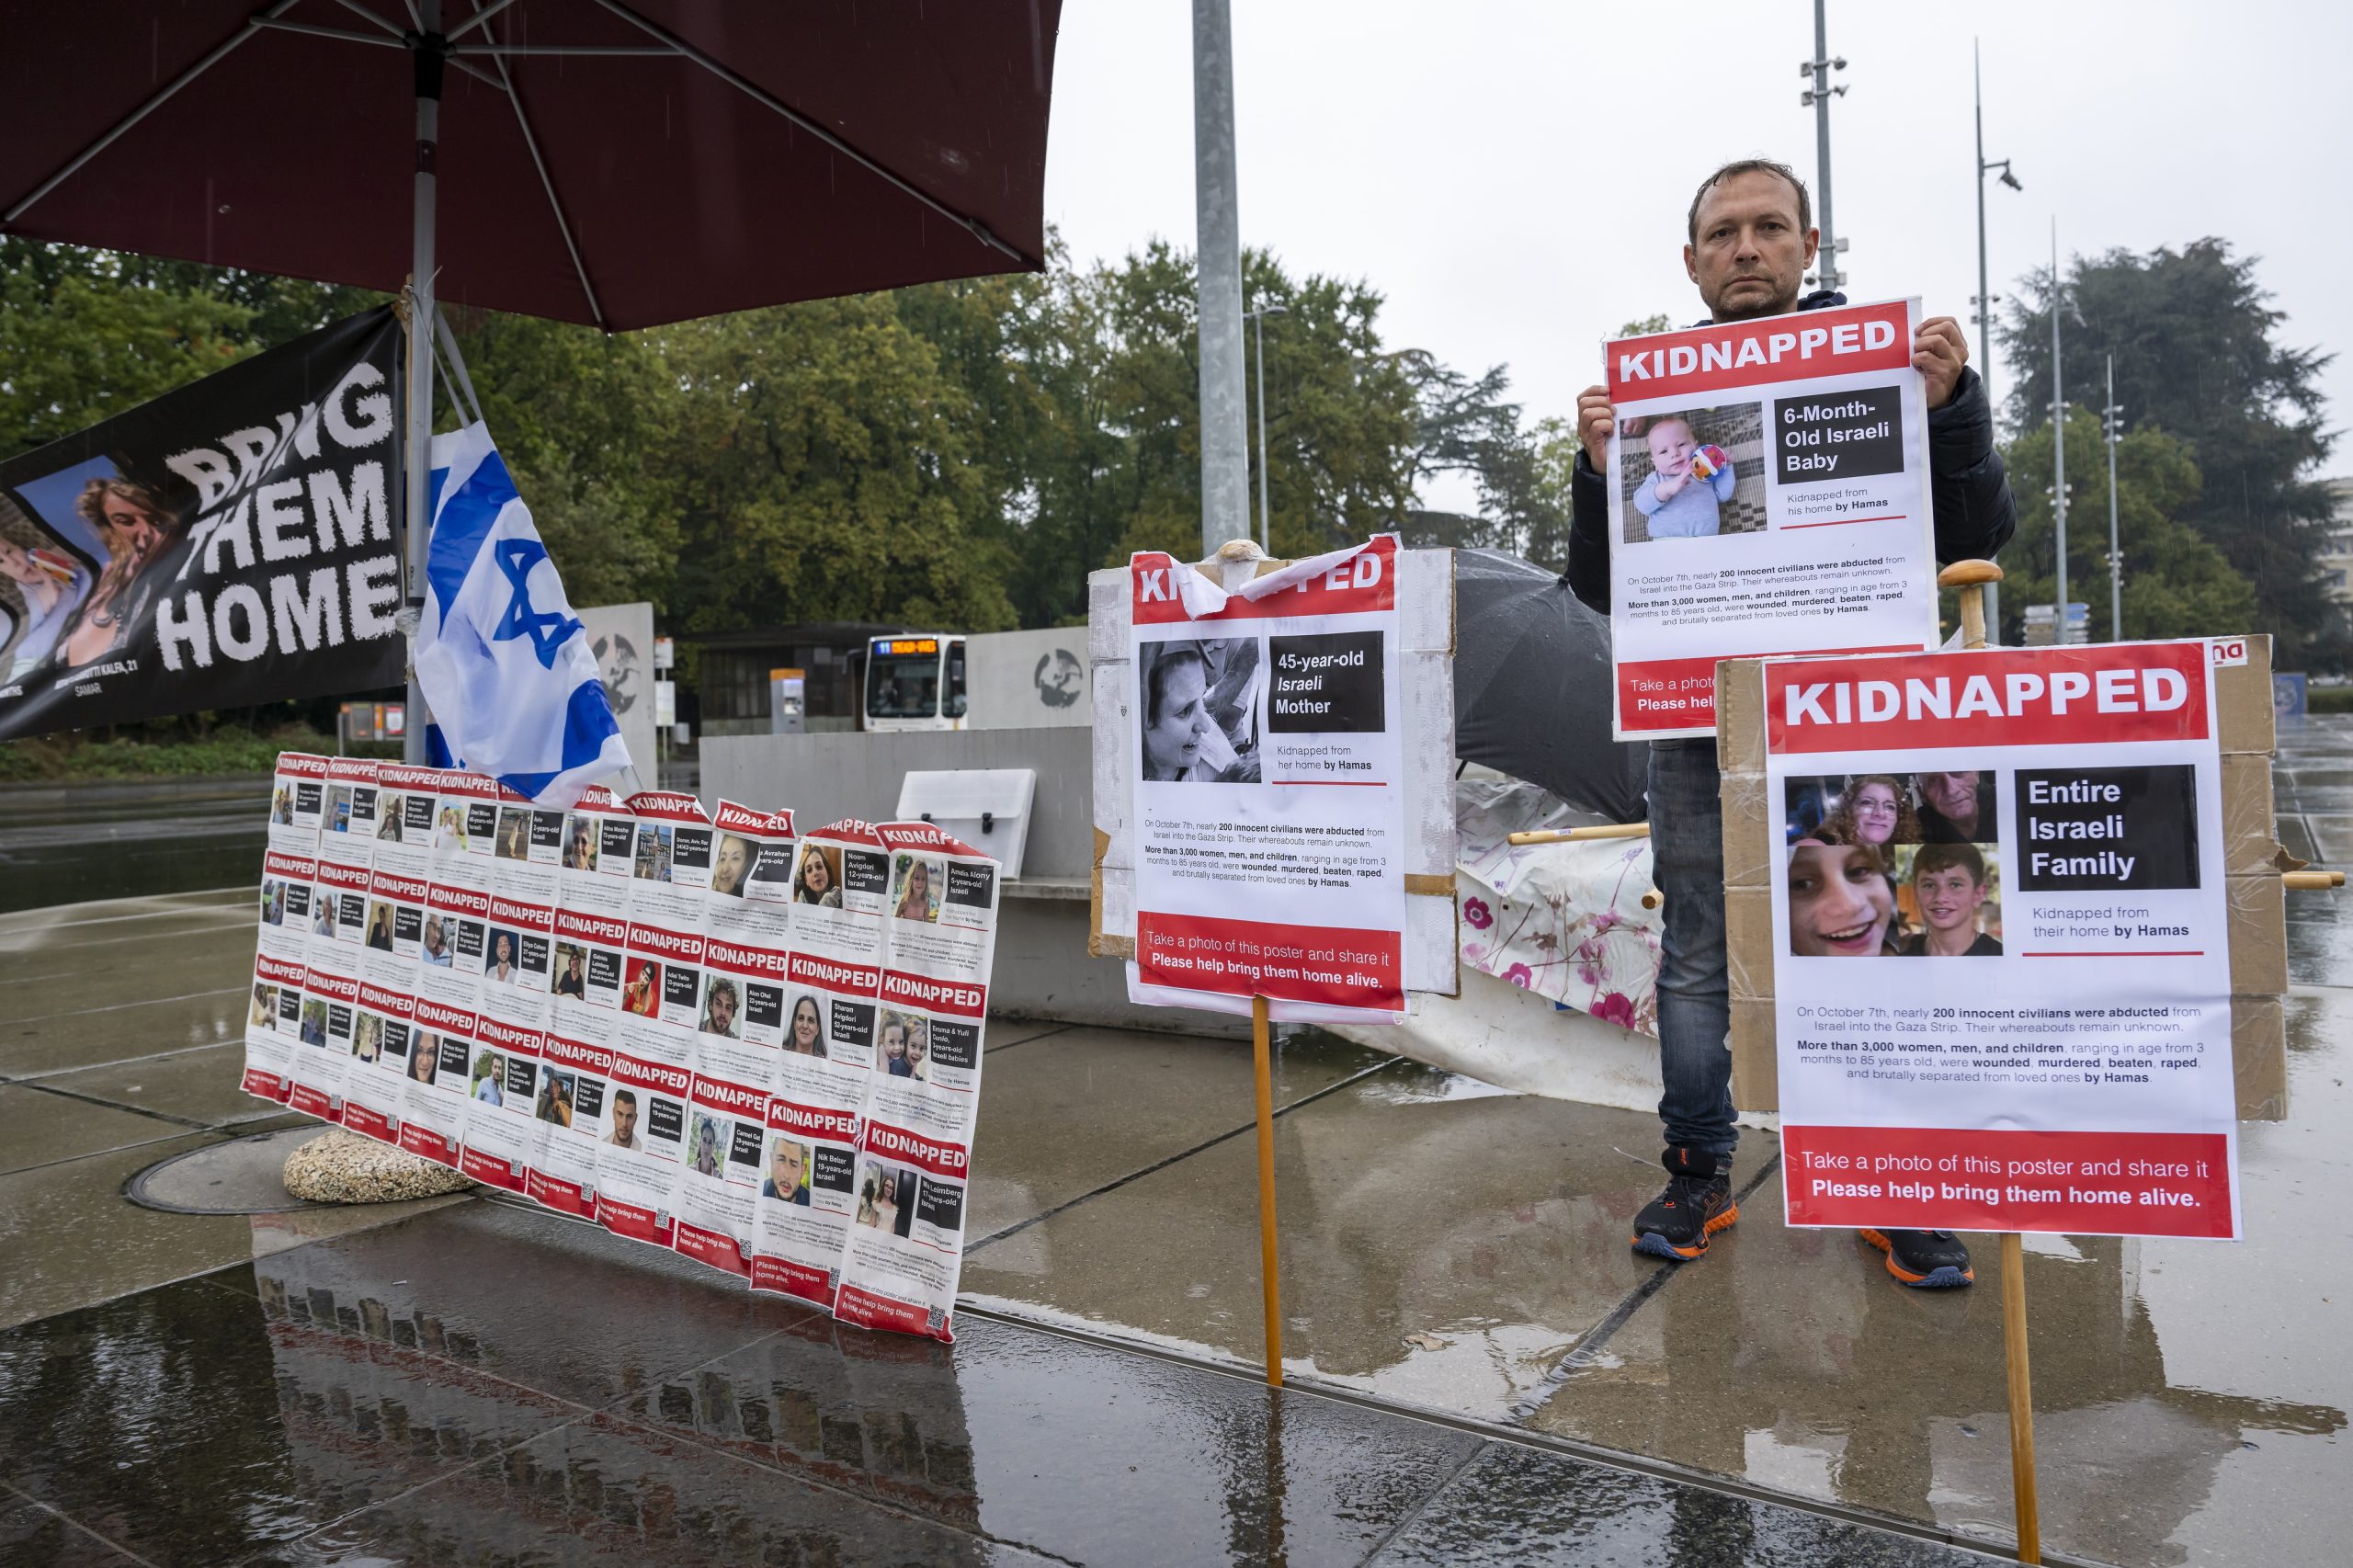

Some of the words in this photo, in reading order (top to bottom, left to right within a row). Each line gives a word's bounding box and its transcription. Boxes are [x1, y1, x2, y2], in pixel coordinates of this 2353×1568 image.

[1620, 320, 1896, 383] KIDNAPPED
[1784, 401, 1876, 425] 6-Month-
[1785, 428, 1821, 448] Old
[1826, 421, 1889, 444] Israeli
[1787, 453, 1838, 472] Baby
[1788, 490, 1842, 504] Kidnapped
[1845, 488, 1868, 497] from
[1788, 507, 1802, 516] his
[1805, 505, 1833, 514] home
[1836, 503, 1848, 513] by
[1851, 499, 1889, 509] Hamas
[177, 460, 392, 581] THEM
[154, 553, 401, 671] HOME
[127, 659, 138, 671] 21
[1279, 650, 1364, 673] 45-year-old
[1278, 675, 1323, 692] Israeli
[1631, 679, 1665, 692] Take
[1668, 680, 1677, 690] a
[1276, 699, 1331, 714] Mother
[1638, 699, 1687, 711] Please
[1690, 695, 1716, 710] hel
[1785, 668, 2189, 726] KIDNAPPED
[1277, 745, 1328, 757] Kidnapped
[1330, 745, 1351, 756] from
[278, 757, 326, 773] KIDNAPPED
[330, 763, 376, 777] KIDNAPPE
[1278, 760, 1292, 770] her
[1295, 760, 1322, 769] home
[1324, 760, 1336, 772] by
[1338, 760, 1372, 770] Hamas
[379, 769, 439, 785] KIDNAPPED
[440, 776, 497, 792] KIDNAPPED
[2029, 779, 2121, 804] Entire
[2029, 814, 2123, 840] Israeli
[268, 856, 315, 874] KIDNAPPED
[320, 865, 369, 884] KIDNAPPED
[2031, 851, 2136, 881] Family
[373, 876, 426, 896] KIDNAPPED
[430, 888, 488, 910] KIDNAPPED
[493, 902, 552, 925] KIDNAPPED
[2033, 907, 2112, 921] Kidnapped
[2117, 906, 2150, 918] from
[558, 915, 624, 938] KIDNAPPED
[2033, 926, 2064, 937] their
[2070, 926, 2109, 937] home
[2114, 925, 2132, 939] by
[2138, 925, 2189, 937] Hamas
[631, 928, 702, 954] KIDNAPPED
[1147, 930, 1175, 947] Take
[1177, 937, 1186, 948] a
[1188, 936, 1222, 951] photo
[1224, 939, 1236, 952] of
[1238, 940, 1260, 956] this
[1263, 946, 1304, 960] poster
[1308, 948, 1335, 961] and
[1338, 949, 1378, 965] share
[1381, 951, 1390, 967] it
[708, 944, 786, 971] KIDNAPPED
[259, 960, 304, 981] KIDNAPPED
[792, 958, 878, 988] KIDNAPPED
[1152, 952, 1193, 969] Please
[1197, 956, 1224, 975] help
[1227, 960, 1260, 980] bring
[1263, 964, 1300, 980] them
[1302, 967, 1343, 984] home
[1346, 971, 1382, 989] alive.
[307, 973, 357, 994] KIDNAPPED
[885, 977, 981, 1006] KIDNAPPED
[361, 986, 413, 1012] KIDNAPPED
[417, 1003, 473, 1029] KIDNAPPED
[1797, 1006, 1814, 1017] On
[1817, 1006, 1865, 1017] October
[1869, 1007, 1890, 1018] 7th,
[1893, 1007, 1929, 1020] nearly
[1933, 1007, 1955, 1018] 200
[1959, 1008, 2015, 1018] innocent
[2018, 1008, 2071, 1018] civilians
[2075, 1009, 2106, 1017] were
[2109, 1006, 2169, 1017] abducted
[2173, 1006, 2201, 1017] from
[479, 1021, 540, 1049] KIDNAPPED
[546, 1038, 611, 1068] KIDNAPPED
[1797, 1040, 1828, 1051] More
[1831, 1040, 1859, 1051] than
[1861, 1041, 1894, 1052] 3,000
[1897, 1044, 1947, 1053] women,
[1950, 1045, 1982, 1054] men,
[1985, 1043, 2009, 1053] and
[2012, 1043, 2068, 1053] children,
[2072, 1043, 2120, 1056] ranging
[2123, 1043, 2134, 1053] in
[2138, 1045, 2162, 1056] age
[2165, 1042, 2193, 1053] from
[2197, 1042, 2204, 1053] 3
[614, 1058, 688, 1088] KIDNAPPED
[1801, 1055, 1843, 1064] months
[1846, 1055, 1857, 1065] to
[1860, 1055, 1875, 1065] 85
[1878, 1058, 1911, 1068] years
[1914, 1057, 1936, 1067] old,
[1939, 1059, 1969, 1068] were
[1972, 1057, 2034, 1068] wounded,
[2038, 1058, 2105, 1068] murdered,
[2109, 1058, 2157, 1068] beaten,
[2161, 1057, 2202, 1071] raped,
[695, 1080, 767, 1112] KIDNAPPE
[772, 1106, 857, 1134] KIDNAPPED
[871, 1128, 965, 1168] KIDNAPPED
[1802, 1151, 1849, 1169] Take
[1856, 1156, 1869, 1170] a
[1875, 1153, 1933, 1174] photo
[1938, 1154, 1959, 1172] of
[1963, 1155, 2001, 1174] this
[2008, 1159, 2075, 1178] poster
[2081, 1158, 2120, 1176] and
[2128, 1159, 2189, 1177] share
[2197, 1160, 2209, 1178] it
[1813, 1179, 1882, 1198] Please
[1888, 1181, 1935, 1203] help
[1941, 1182, 1999, 1206] bring
[2006, 1185, 2062, 1203] them
[2069, 1186, 2132, 1205] home
[2139, 1187, 2200, 1207] alive.
[896, 1308, 914, 1320] them
